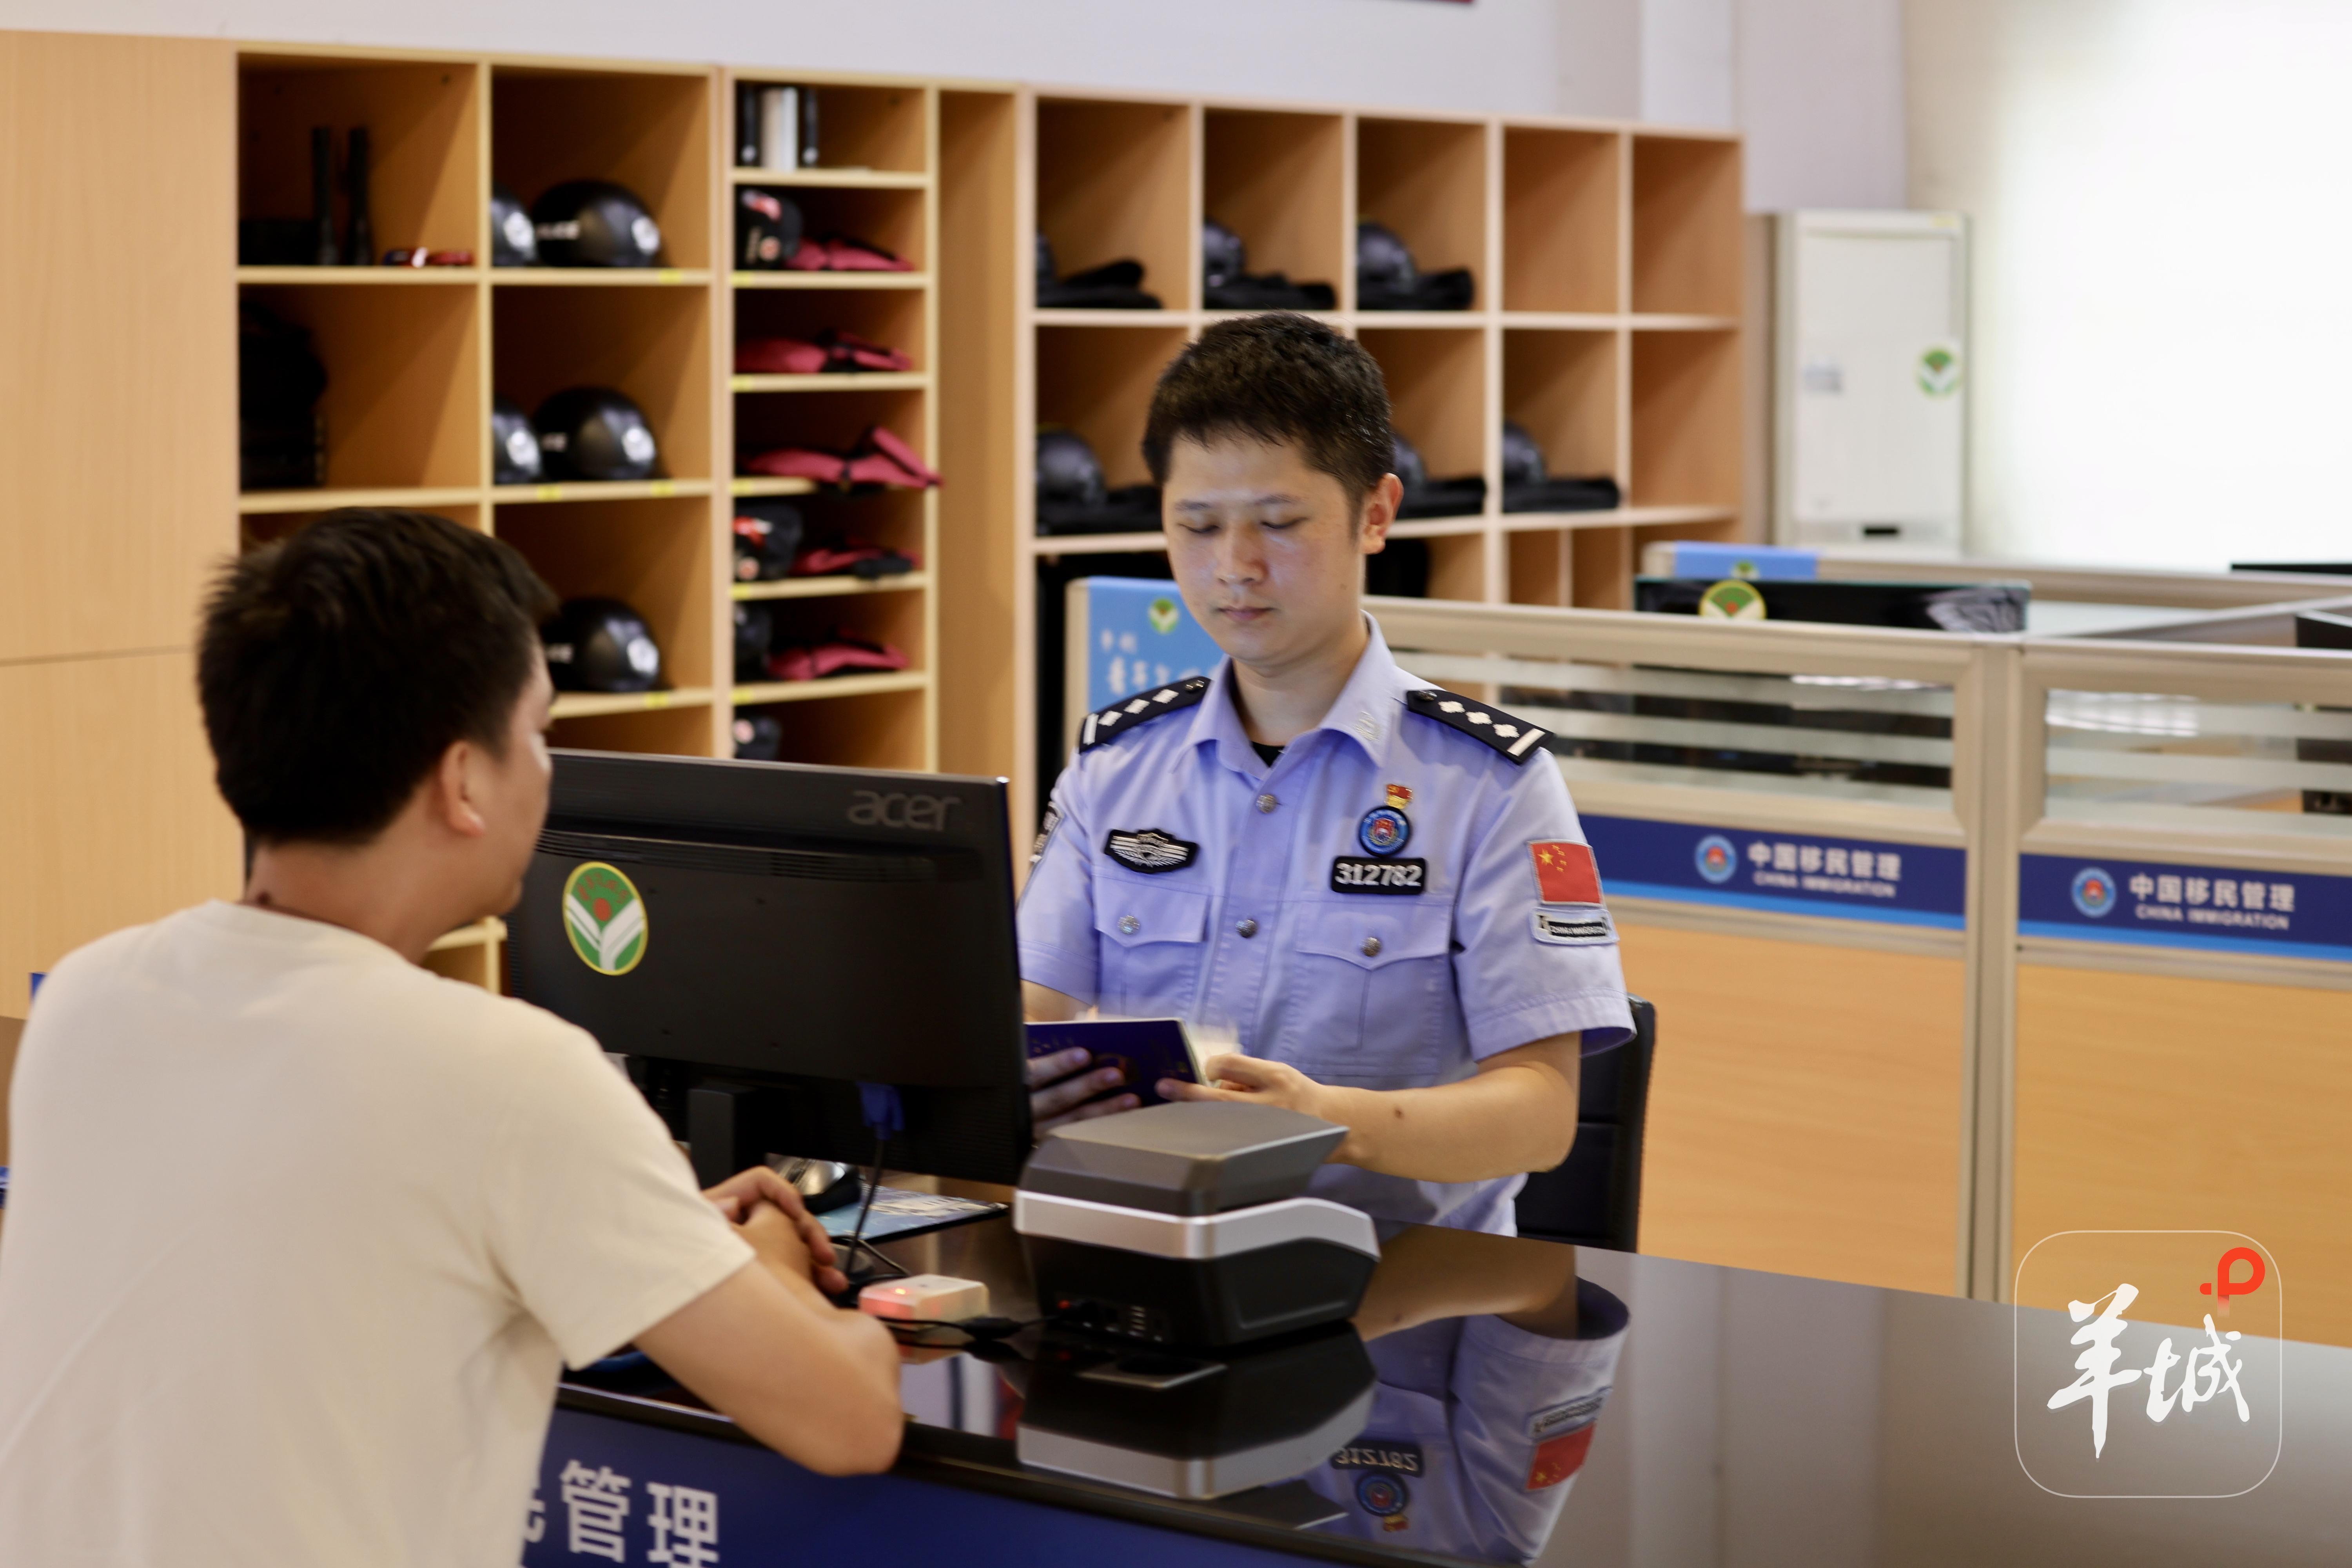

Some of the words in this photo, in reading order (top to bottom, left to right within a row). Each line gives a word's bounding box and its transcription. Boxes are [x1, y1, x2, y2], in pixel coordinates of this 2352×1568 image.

[847, 790, 962, 831] acer
[1334, 863, 1423, 887] 312782
[1748, 841, 1901, 881] 中国移民管理
[2129, 873, 2295, 912] 中国移民管理
[2135, 904, 2183, 921] CHINA
[2187, 908, 2290, 929] IMMIGRATION
